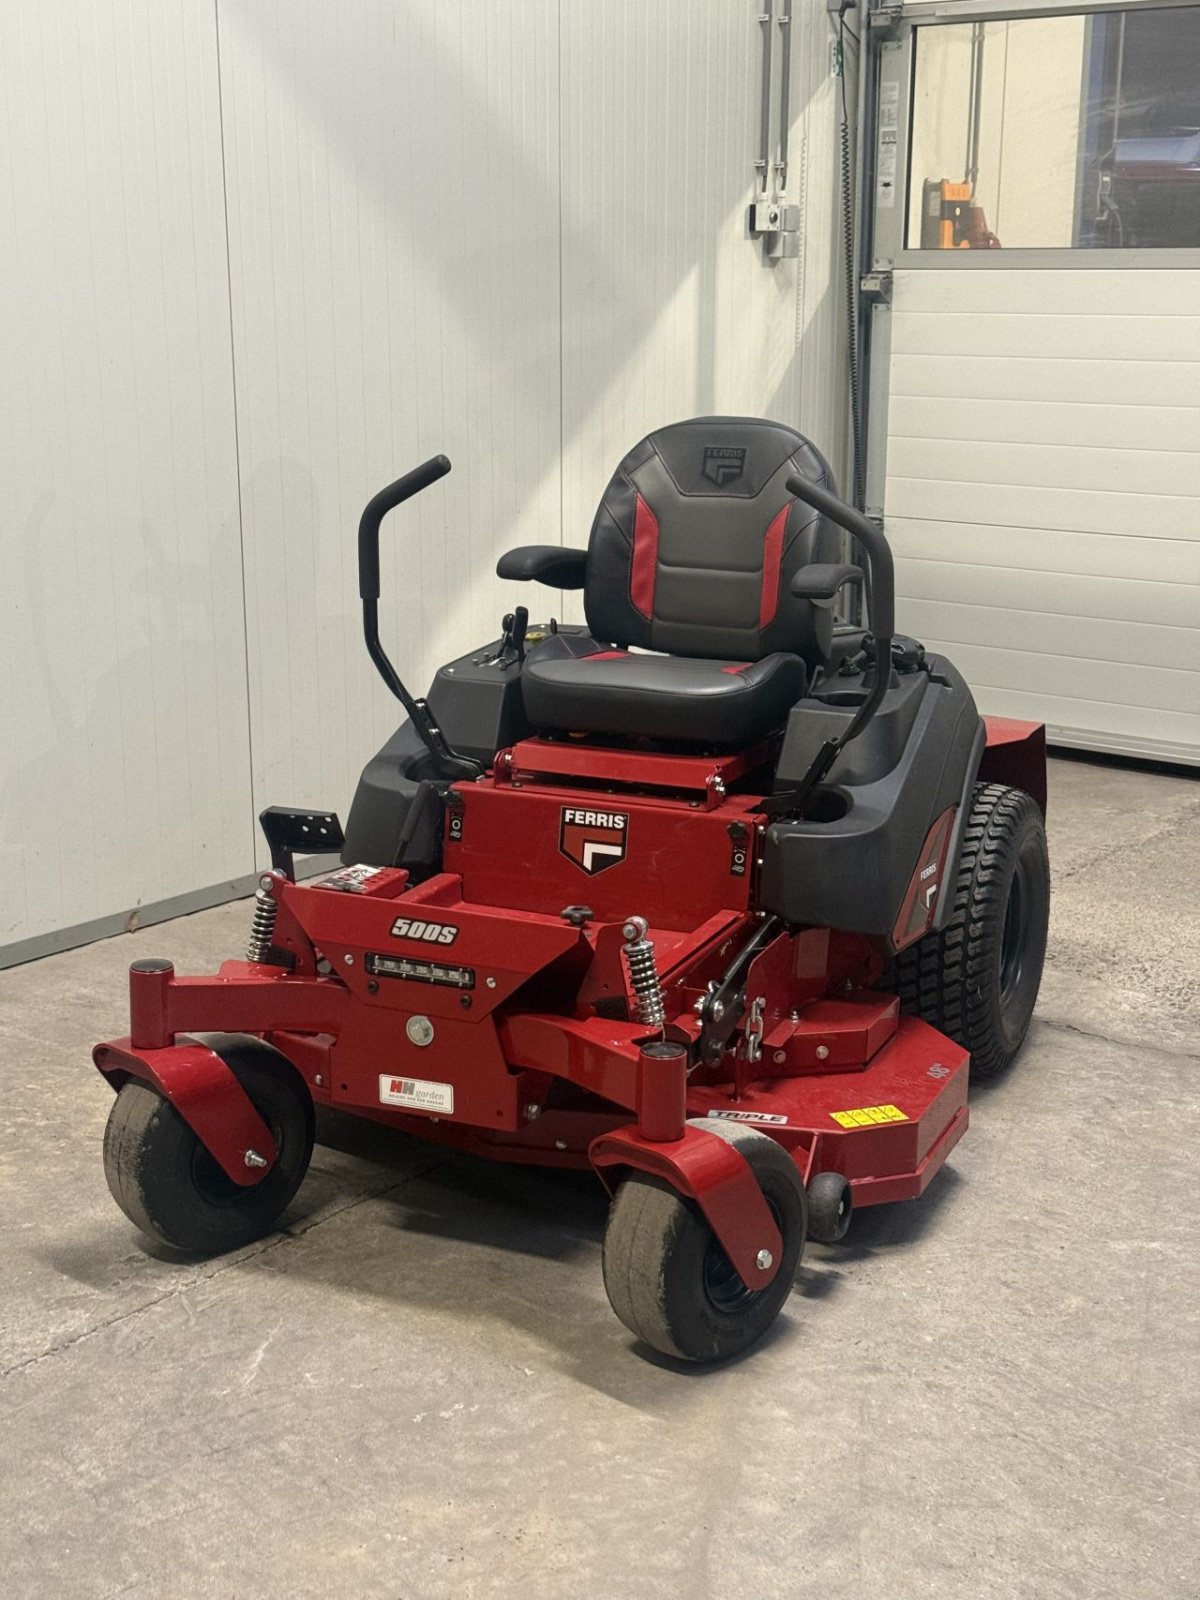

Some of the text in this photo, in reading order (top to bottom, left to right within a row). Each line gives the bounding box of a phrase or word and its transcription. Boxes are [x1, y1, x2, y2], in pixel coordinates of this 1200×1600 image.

[706, 448, 744, 457] FERRIS
[564, 809, 625, 829] FERRIS
[920, 862, 937, 881] FERRIS
[391, 918, 458, 944] 500S
[390, 1079, 444, 1101] HH garden
[715, 1111, 785, 1122] TRIPLE
